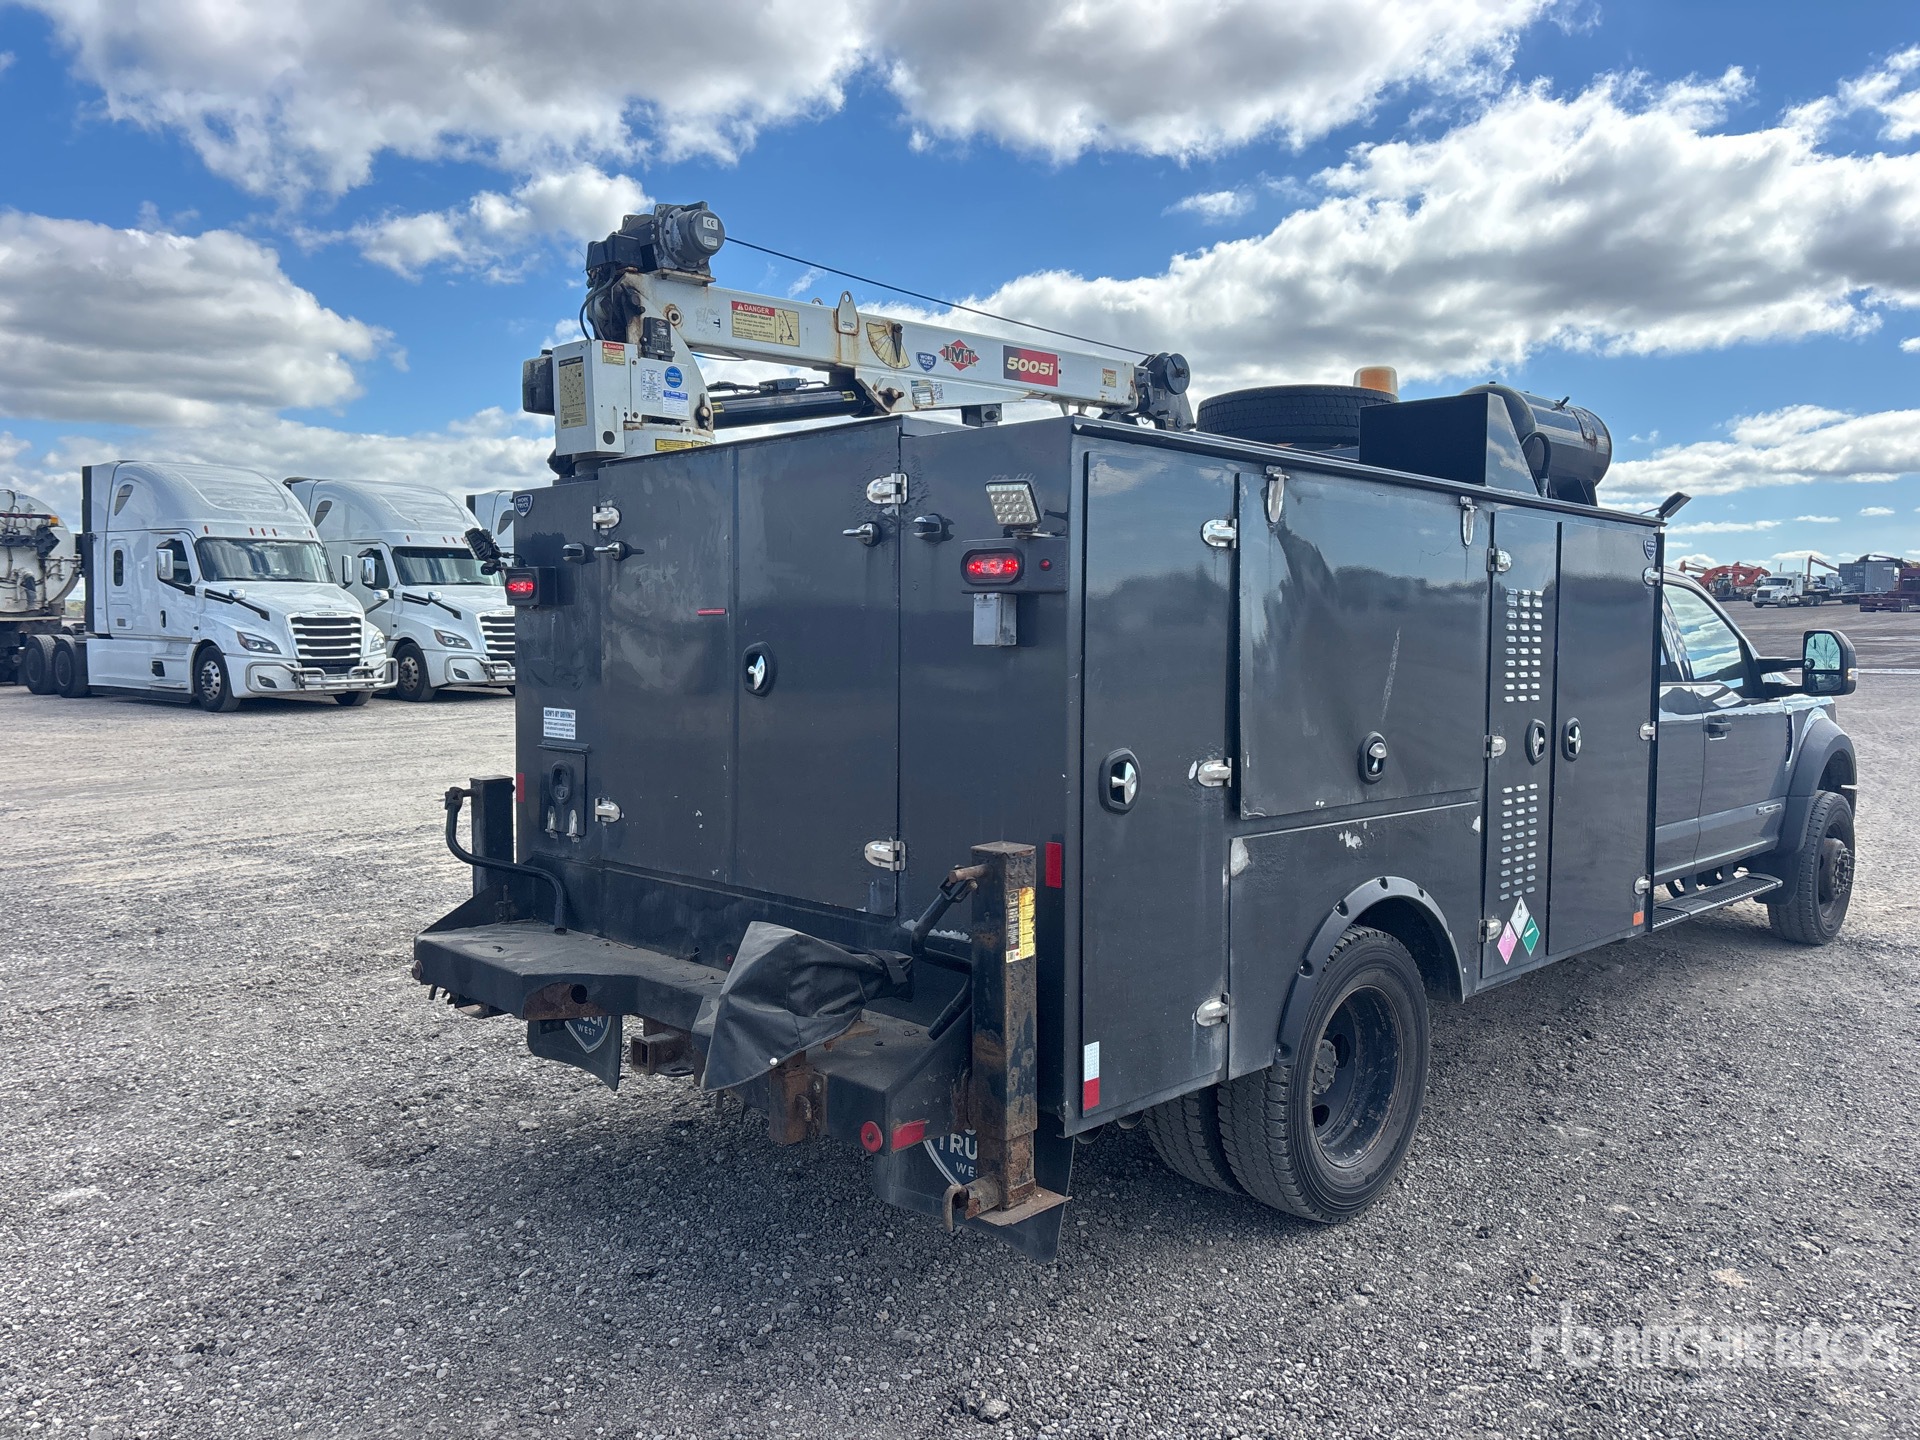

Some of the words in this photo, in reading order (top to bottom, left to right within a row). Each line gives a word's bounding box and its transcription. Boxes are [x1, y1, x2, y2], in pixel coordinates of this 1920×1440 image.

[743, 304, 770, 315] DANGER
[943, 344, 976, 365] IMT
[1006, 356, 1054, 376] 5005i
[577, 1023, 596, 1037] WEST
[955, 1161, 978, 1178] WE
